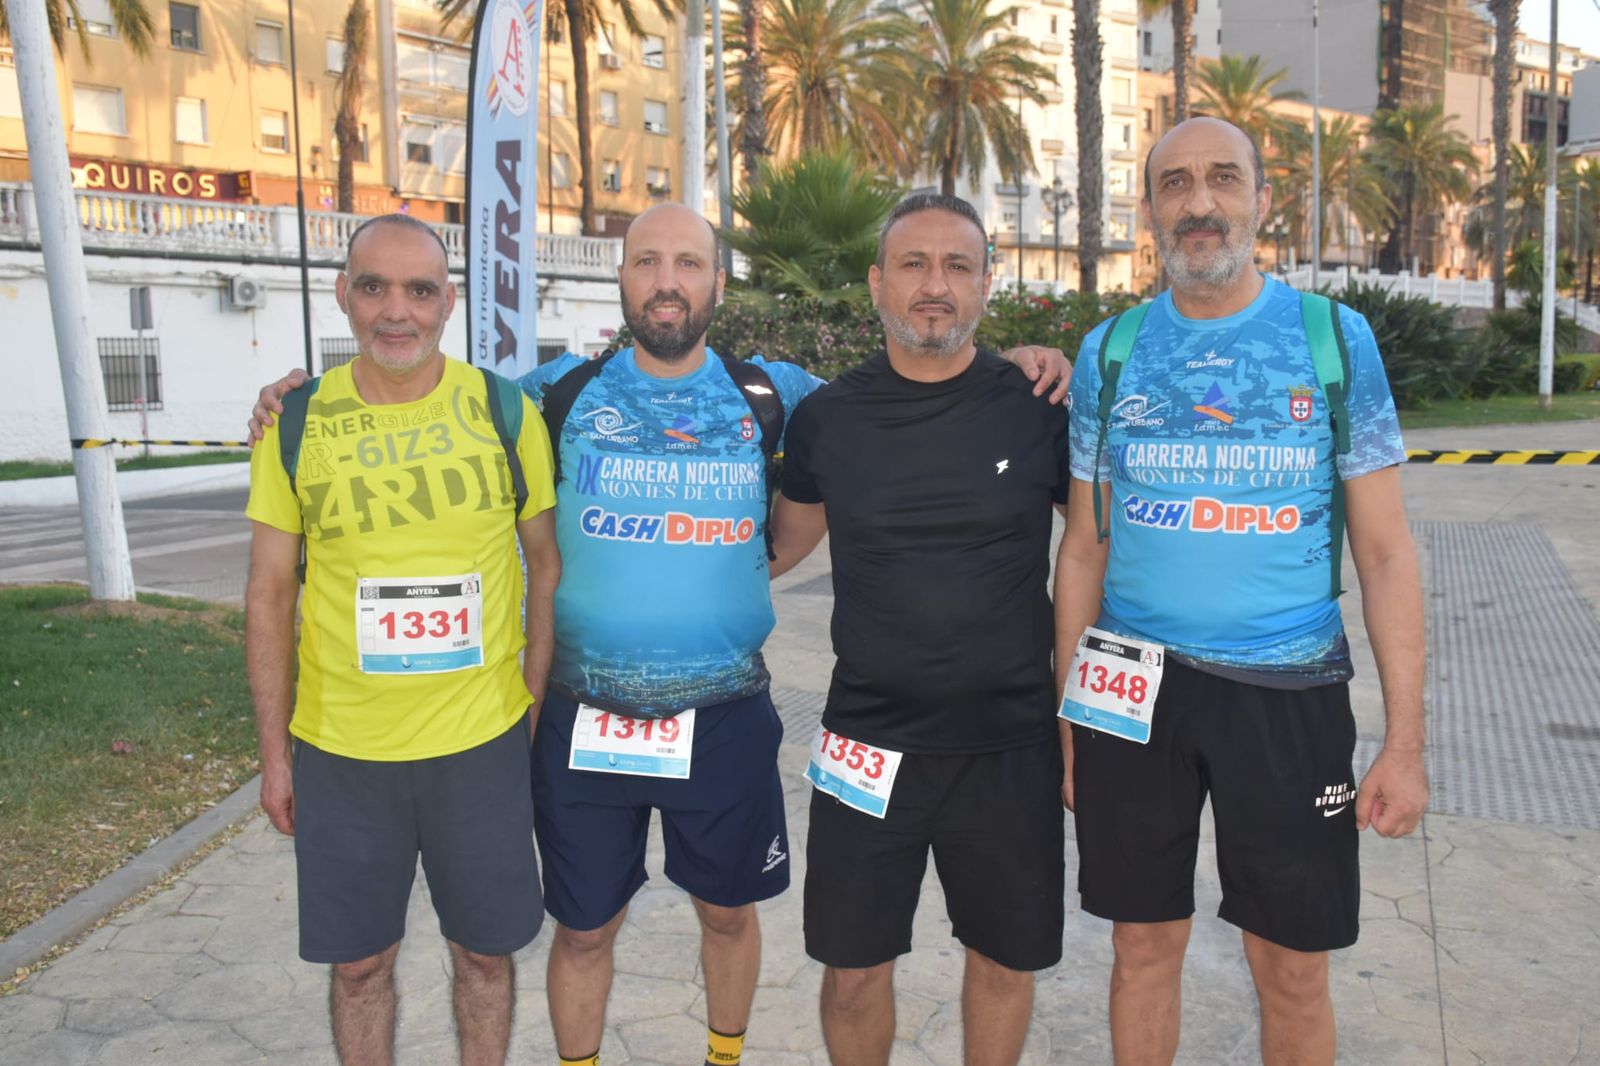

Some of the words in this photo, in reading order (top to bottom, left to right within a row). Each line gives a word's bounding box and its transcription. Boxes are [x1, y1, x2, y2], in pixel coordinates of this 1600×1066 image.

[81, 162, 217, 198] QUIROS
[479, 206, 489, 321] montaña
[476, 329, 489, 360] de
[304, 401, 448, 440] ENERGIZE
[1126, 443, 1208, 469] CARRERA
[1216, 444, 1316, 472] NOCTURNA
[575, 453, 602, 497] IX
[601, 456, 680, 485] CARRERA
[686, 460, 760, 486] NOCTURNA
[600, 479, 676, 500] MONTES
[684, 485, 706, 500] DE
[1214, 470, 1241, 487] DE
[581, 507, 663, 543] CASH
[666, 512, 755, 544] DIPLO
[1122, 494, 1188, 529] CASH
[1191, 497, 1299, 533] DIPLO
[406, 588, 440, 596] ANYERA
[378, 607, 468, 640] 1331
[1099, 642, 1125, 655] ANYERA
[1078, 661, 1148, 704] 1348
[594, 711, 680, 743] 1319
[820, 730, 885, 780] 1353
